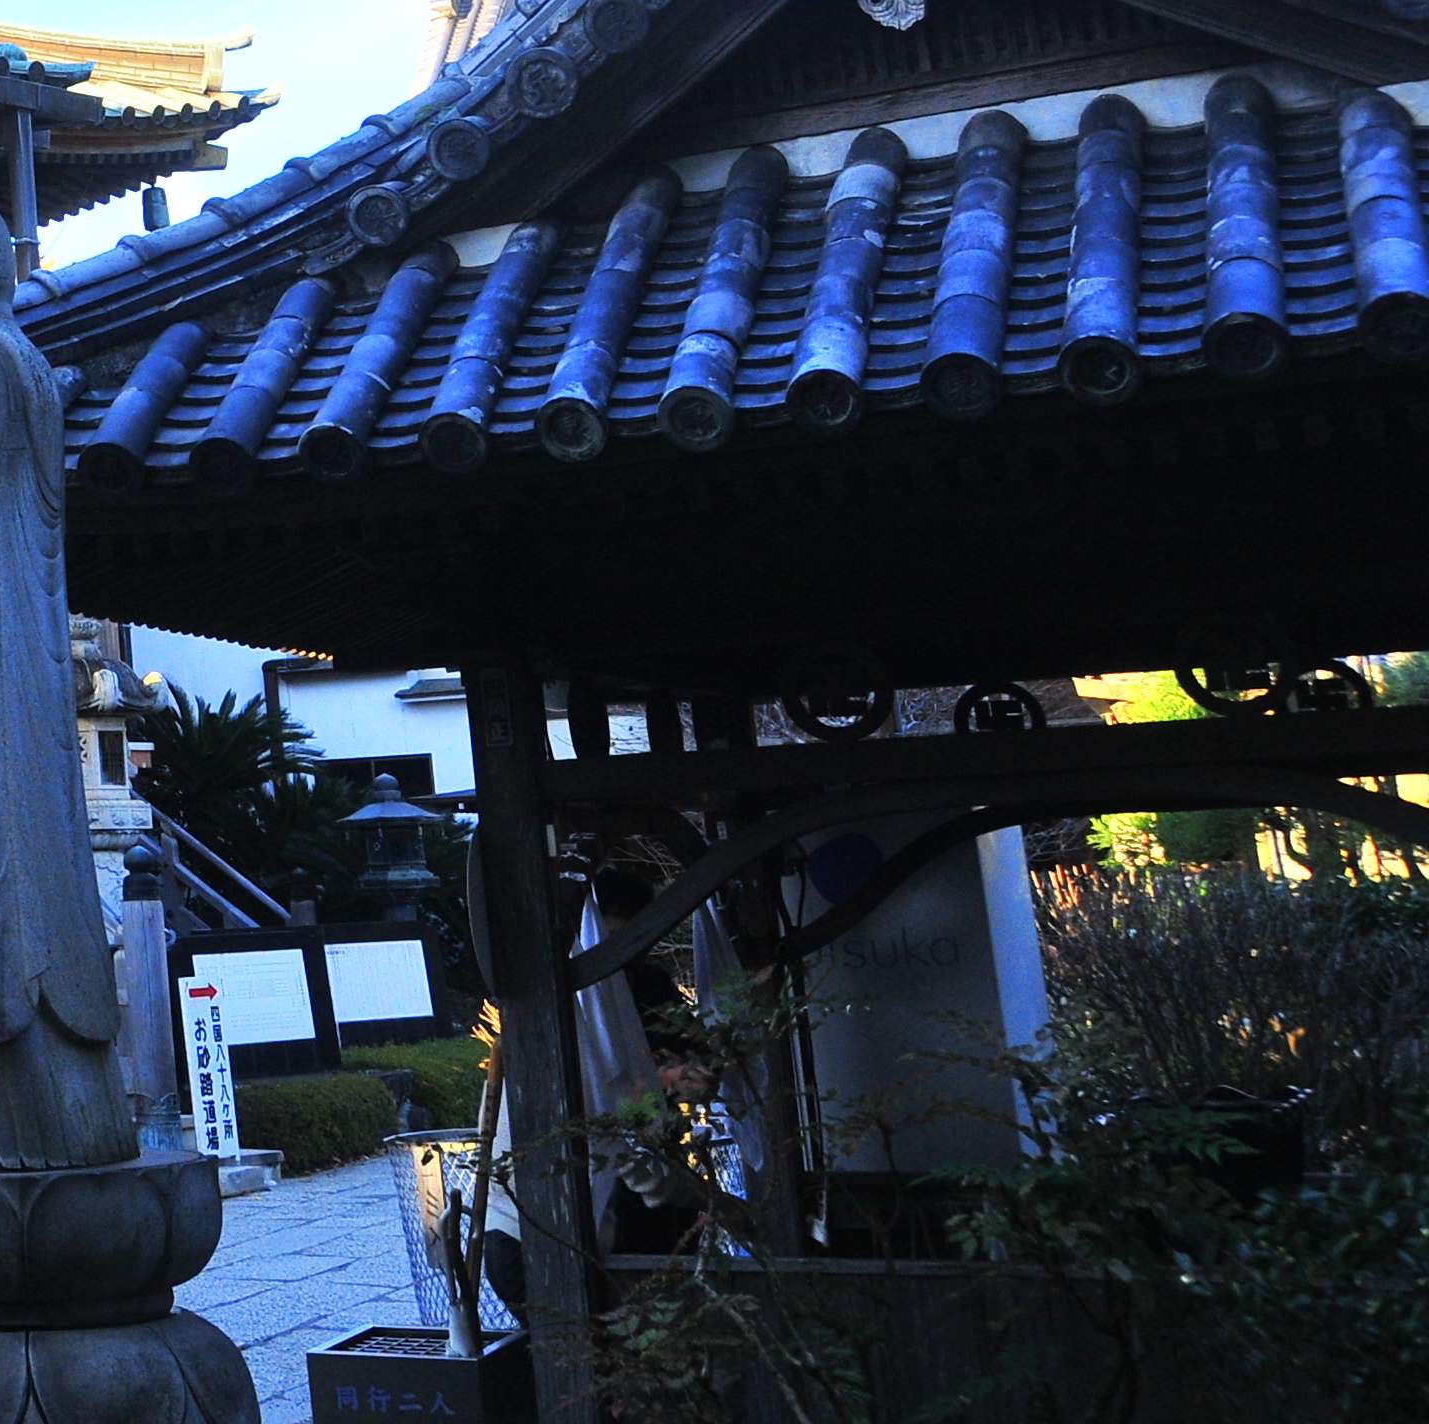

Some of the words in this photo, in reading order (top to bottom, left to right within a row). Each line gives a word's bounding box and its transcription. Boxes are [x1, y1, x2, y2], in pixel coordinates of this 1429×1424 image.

[194, 1018, 220, 1151] お砂踏道場
[335, 1385, 456, 1415] 同行二人
